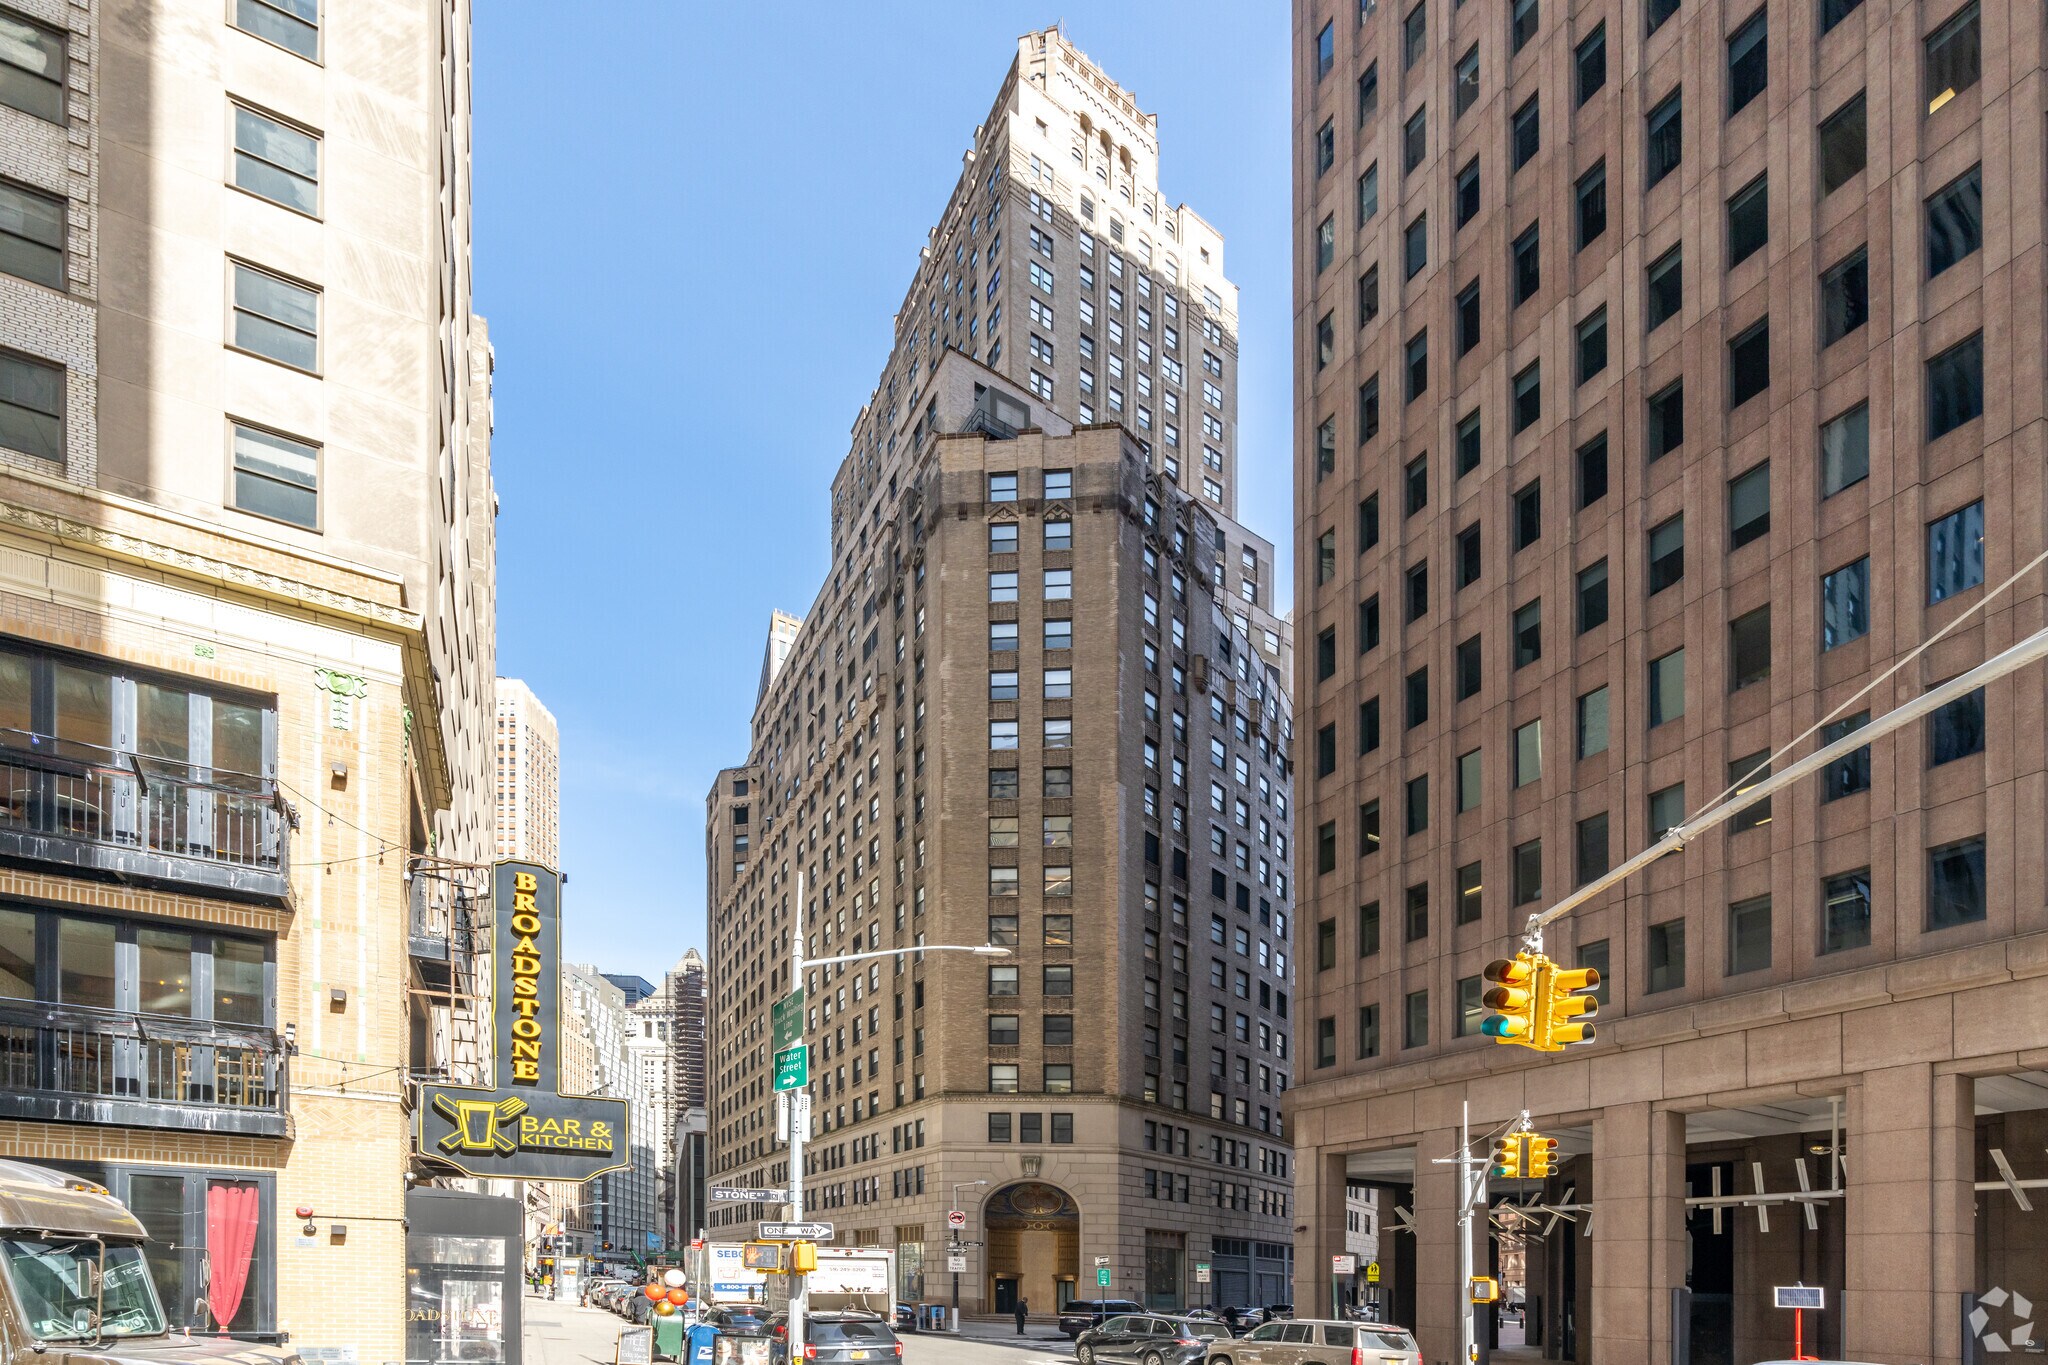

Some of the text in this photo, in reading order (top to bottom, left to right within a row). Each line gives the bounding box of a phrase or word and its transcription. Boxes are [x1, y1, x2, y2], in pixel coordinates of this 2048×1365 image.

[511, 872, 542, 1080] BROADSTONE
[779, 1051, 802, 1063] Water
[780, 1062, 802, 1074] Street
[521, 1115, 612, 1138] BAR &
[521, 1133, 613, 1150] KITCHEN
[715, 1190, 757, 1200] STONE
[766, 1227, 823, 1235] ONE WAY
[623, 1334, 647, 1347] FREE
